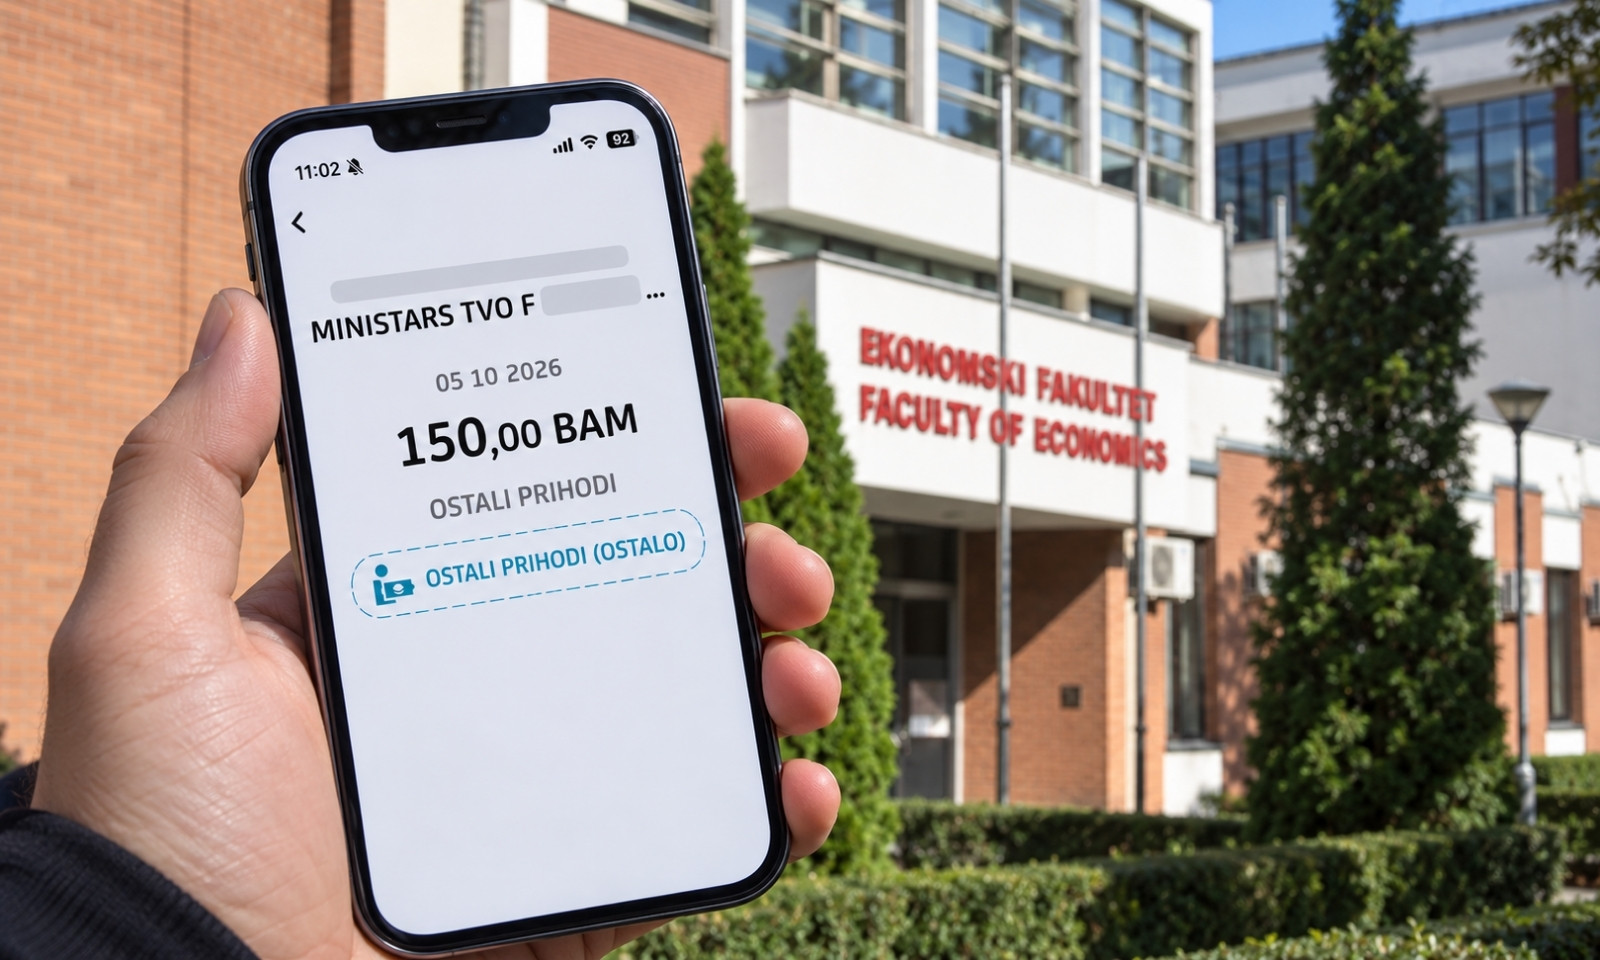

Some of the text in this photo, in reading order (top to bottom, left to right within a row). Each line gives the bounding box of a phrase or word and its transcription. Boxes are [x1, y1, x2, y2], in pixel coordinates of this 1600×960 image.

[612, 133, 631, 146] 92
[294, 161, 342, 181] 11:02
[311, 303, 455, 344] MINISTARS
[459, 296, 514, 324] TVO
[520, 292, 535, 317] F
[435, 358, 562, 393] 05 10 2026
[860, 326, 1157, 423] EKONOMSKI FAKULTET
[396, 402, 638, 468] 150,00 BAM
[860, 384, 1168, 473] FACULTY OF ECONOMICS
[429, 472, 617, 520] OSTALI PRIHODI
[425, 530, 686, 588] OSTALI PRIHODI (OSTALO)
